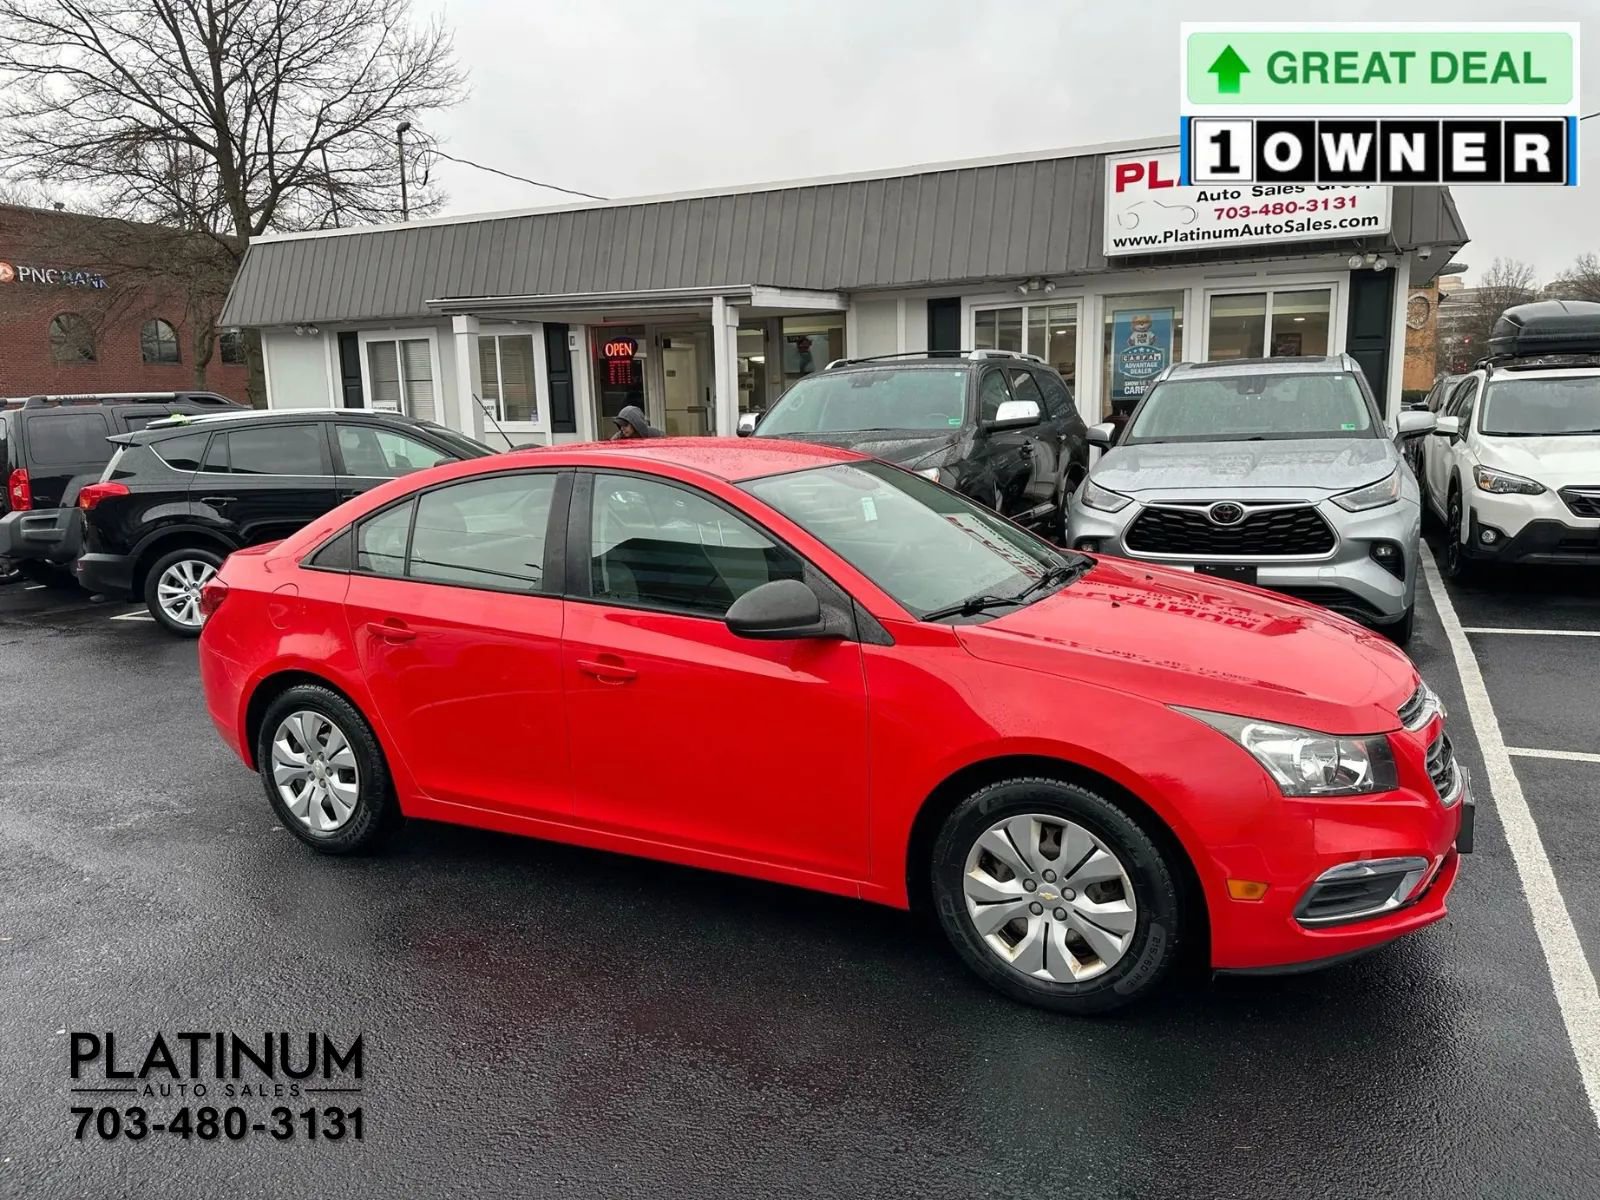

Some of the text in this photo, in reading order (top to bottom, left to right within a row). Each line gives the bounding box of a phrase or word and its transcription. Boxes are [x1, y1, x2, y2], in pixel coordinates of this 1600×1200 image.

[1115, 160, 1181, 193] PL
[1196, 185, 1305, 202] Auto Sales
[1214, 196, 1357, 220] 703-480-3131
[1113, 215, 1379, 247] www.PlatinumAutoSales.com
[17, 265, 59, 284] PNC
[605, 342, 632, 356] OPEN
